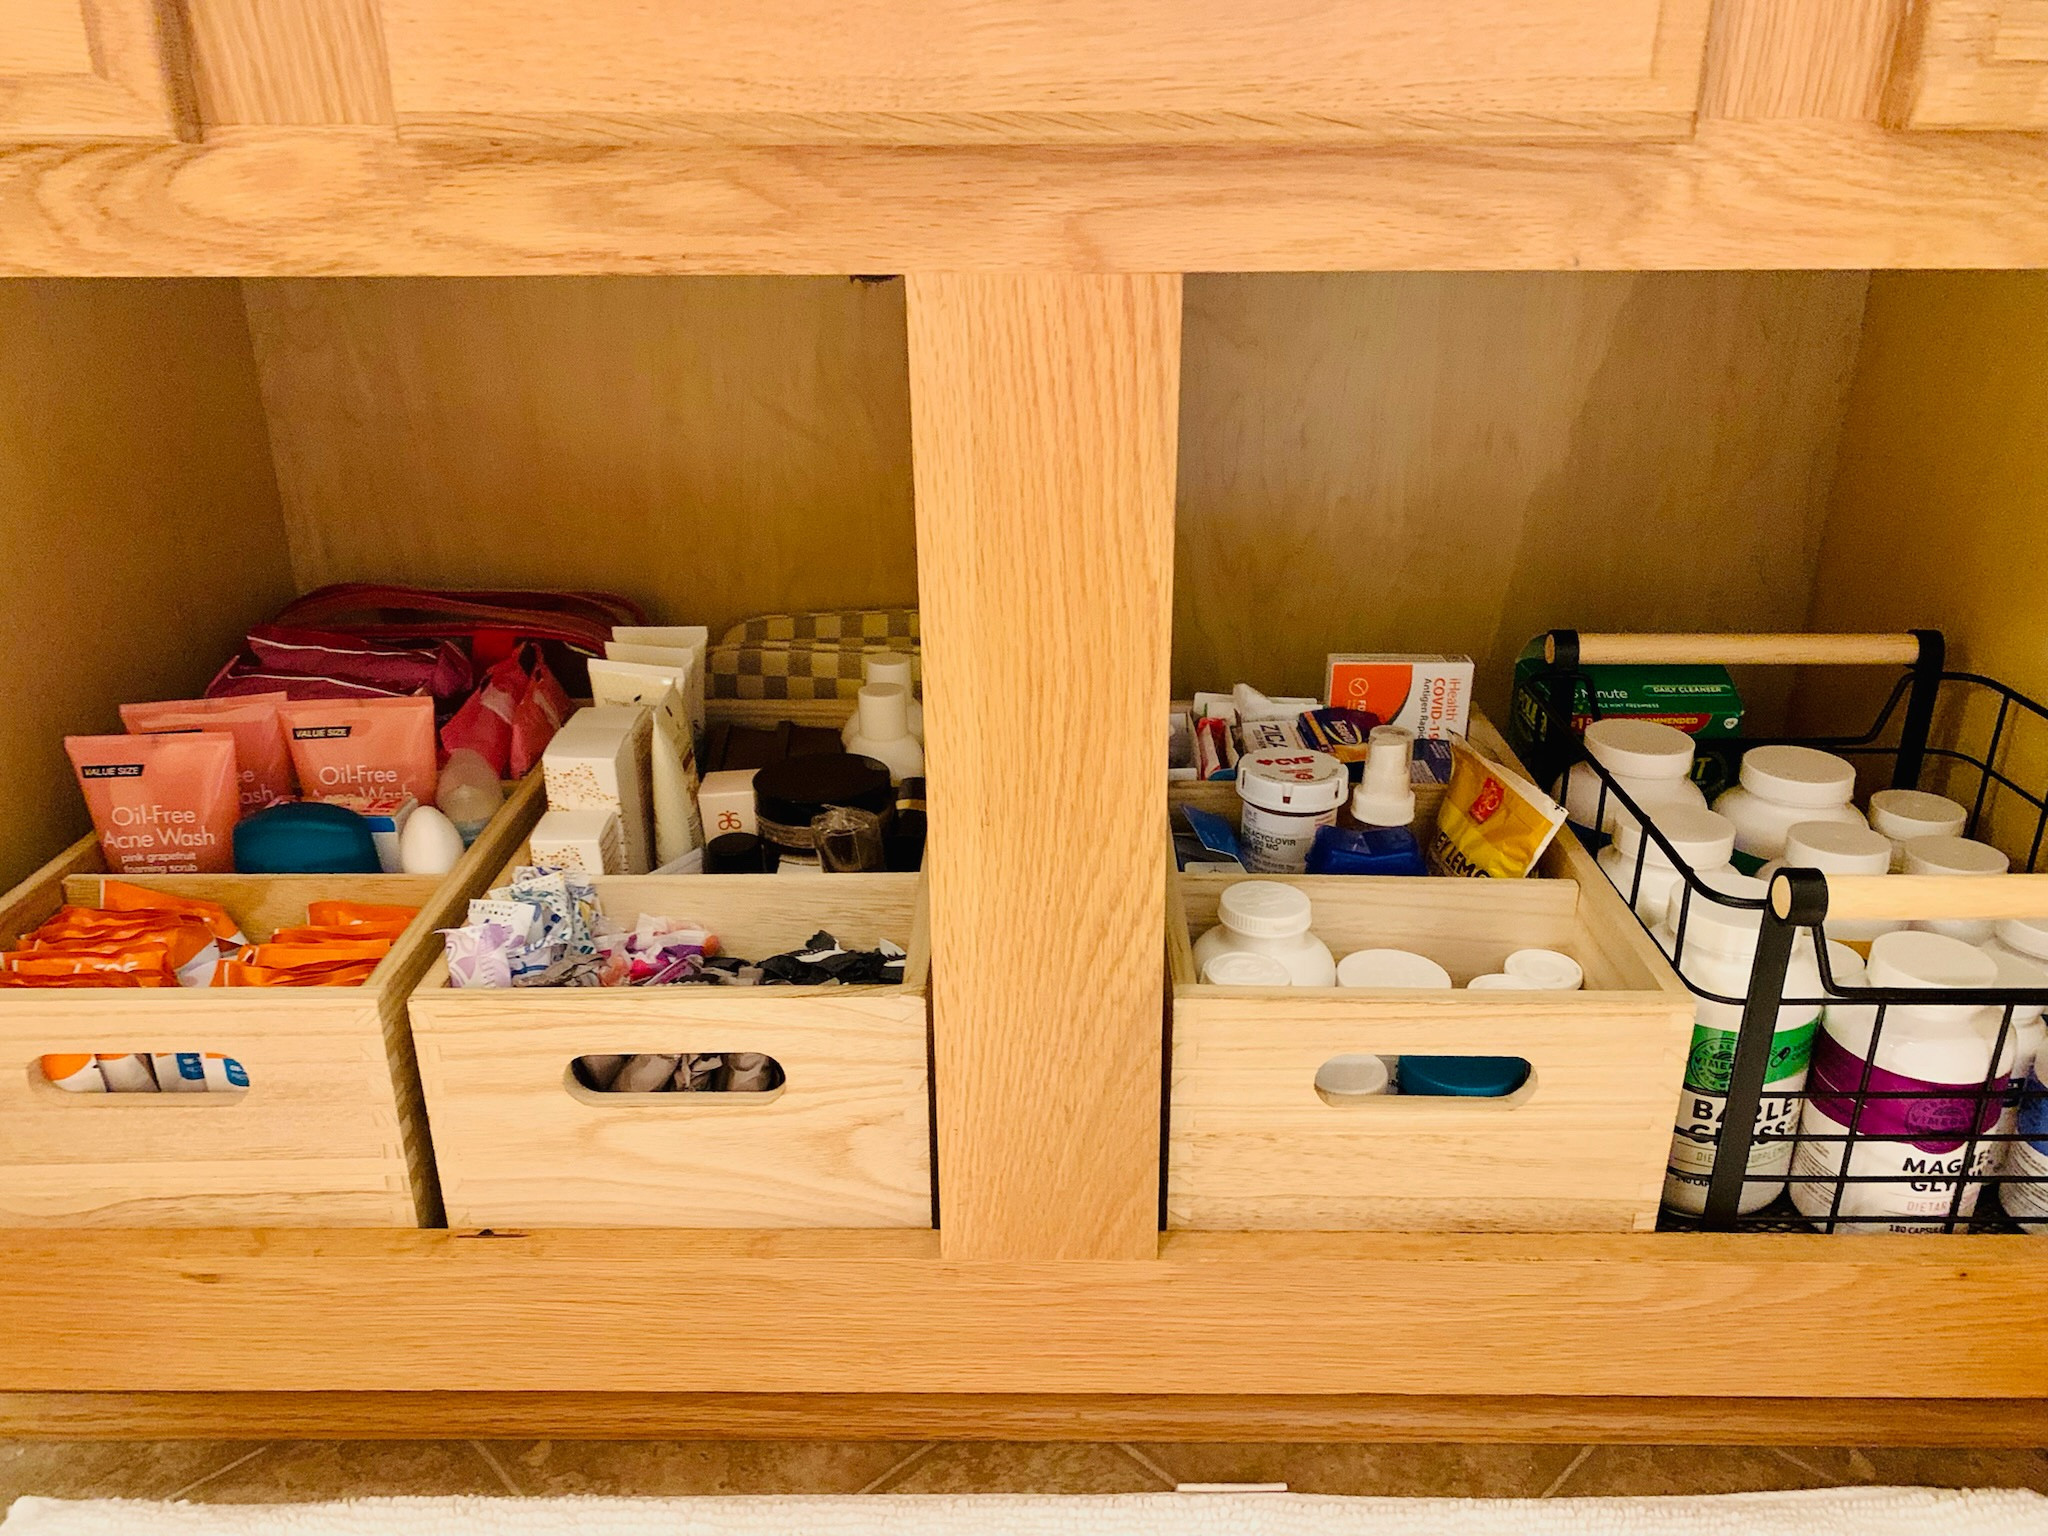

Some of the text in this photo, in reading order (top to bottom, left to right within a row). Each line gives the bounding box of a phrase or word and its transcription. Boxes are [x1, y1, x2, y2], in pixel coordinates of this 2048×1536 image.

[1420, 678, 1432, 718] Antigen
[295, 727, 348, 738] VALUE SIZE
[84, 766, 140, 776] VALUE SIZE
[318, 763, 398, 785] Oil-Free
[111, 804, 196, 827] Oil-Free
[103, 825, 216, 849] Acne Wash
[121, 852, 145, 864] pink
[168, 863, 198, 873] scrub
[1906, 1200, 1950, 1212] DIETAR
[1889, 1224, 1906, 1234] 180
